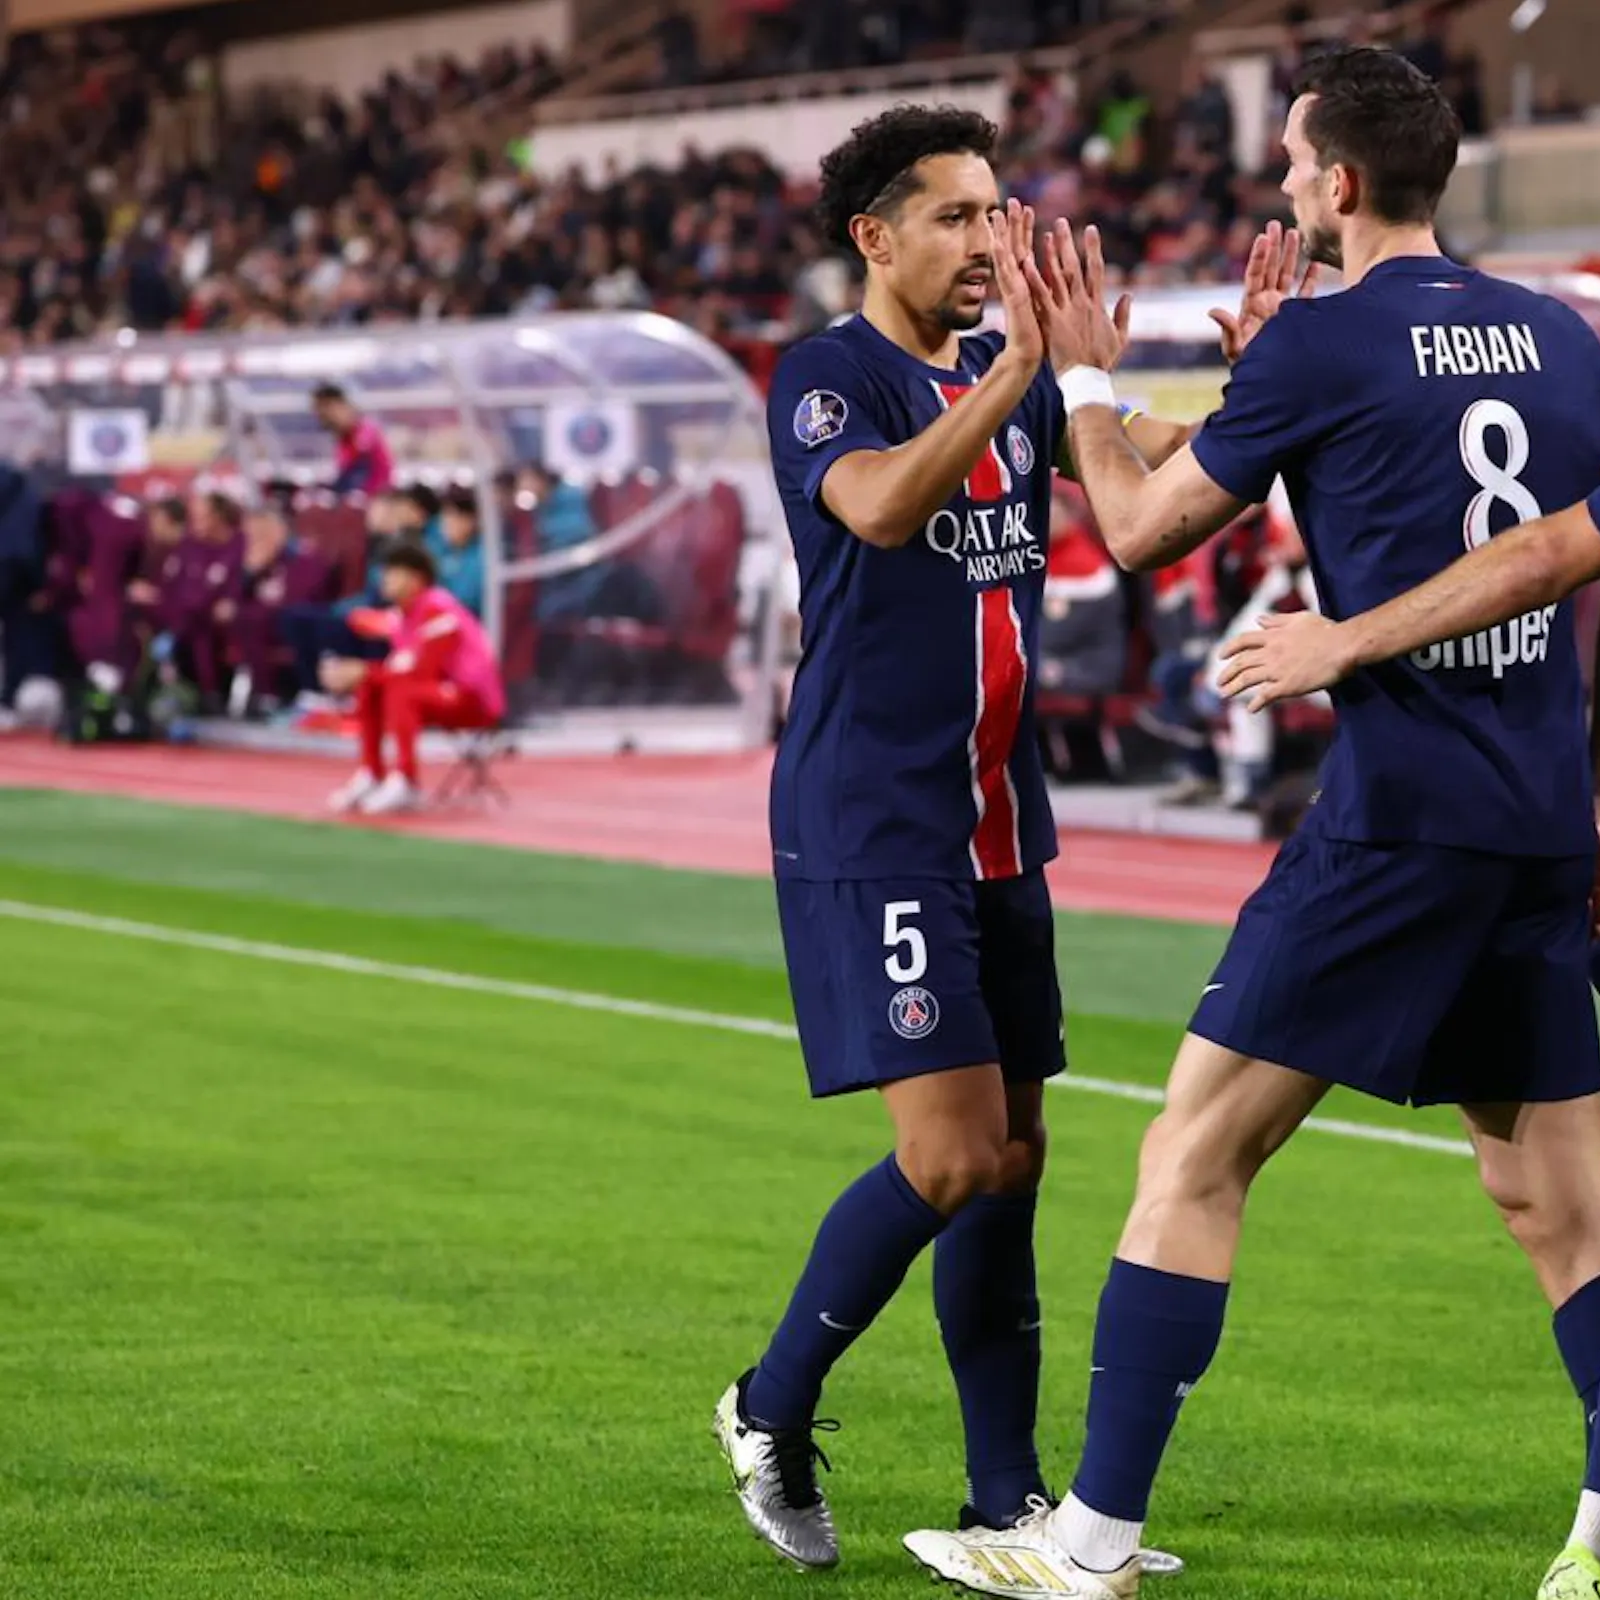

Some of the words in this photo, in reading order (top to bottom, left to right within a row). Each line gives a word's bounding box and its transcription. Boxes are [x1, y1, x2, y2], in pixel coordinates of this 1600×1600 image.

[1410, 323, 1541, 377] FABIAN
[1459, 399, 1542, 551] 8
[925, 501, 1036, 563] QATAR
[966, 545, 1046, 582] AIRWAYS
[883, 900, 928, 983] 5
